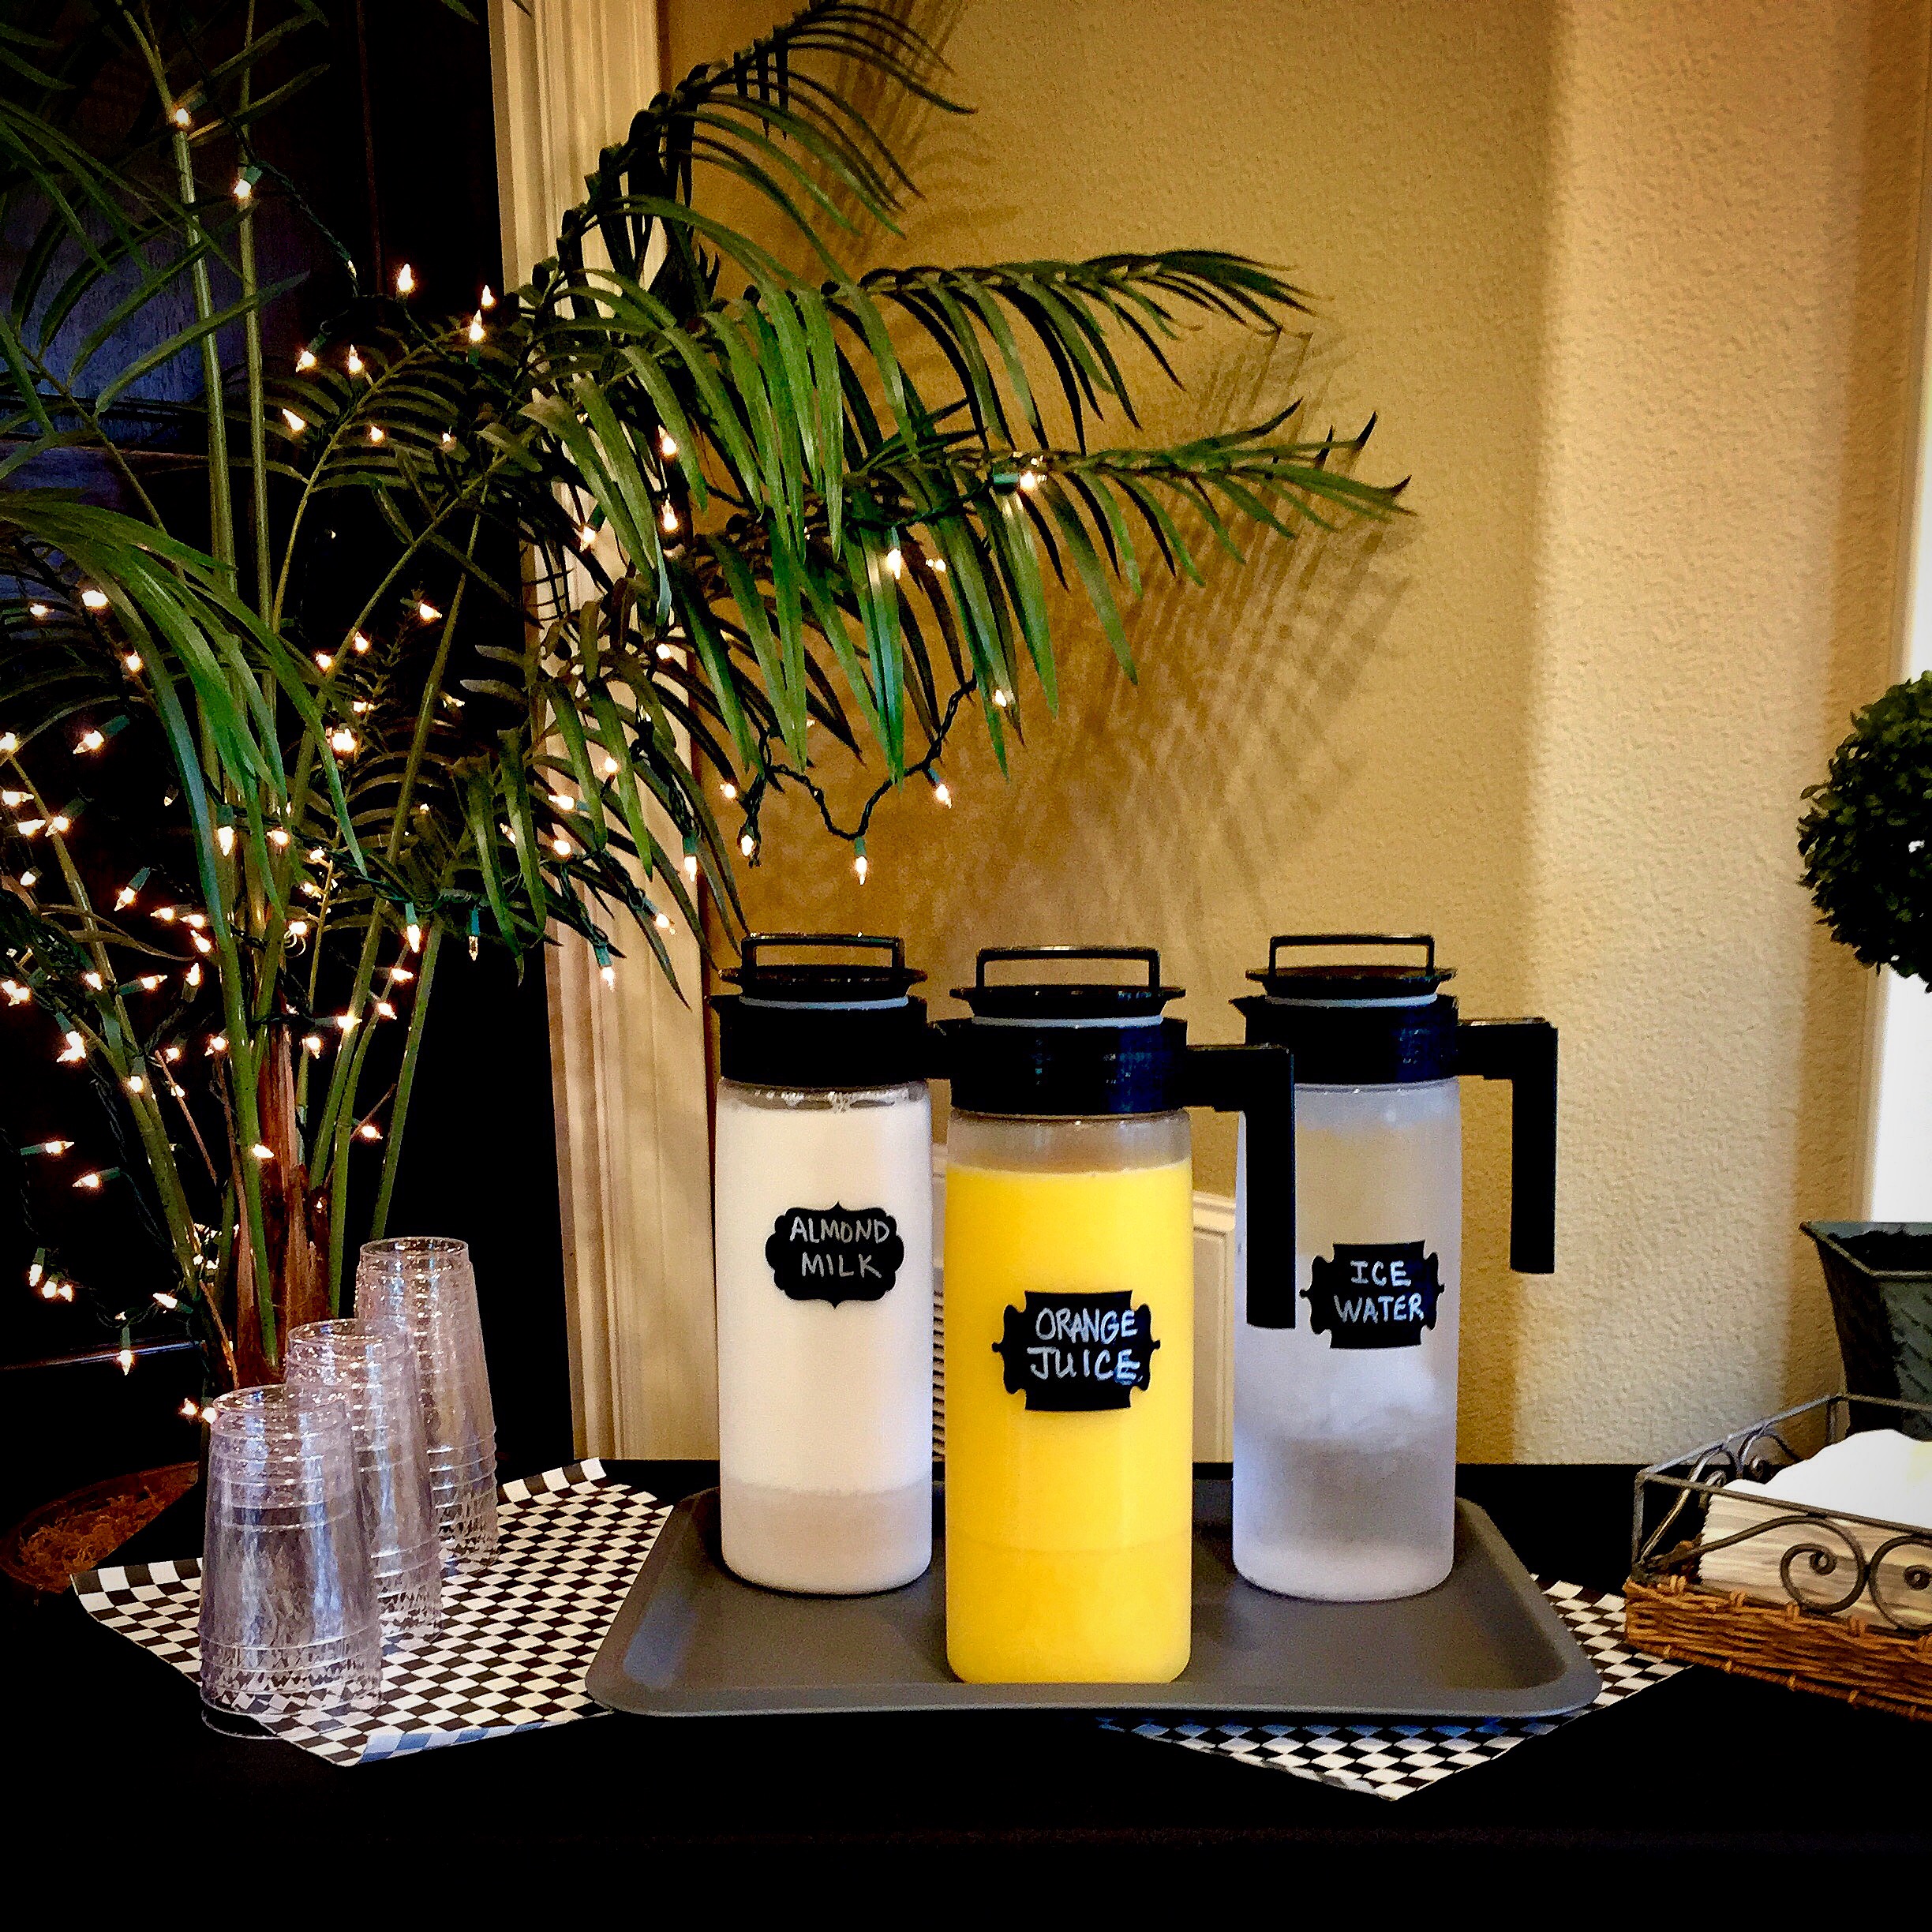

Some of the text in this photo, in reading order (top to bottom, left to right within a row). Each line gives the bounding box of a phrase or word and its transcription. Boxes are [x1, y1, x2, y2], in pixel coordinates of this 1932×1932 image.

[789, 1216, 890, 1244] ALMOND
[801, 1252, 882, 1279] MILK
[1350, 1260, 1412, 1287] ICE
[1334, 1292, 1425, 1324] WATER
[1035, 1307, 1138, 1345] ORANGE
[1027, 1346, 1141, 1383] JUICE
